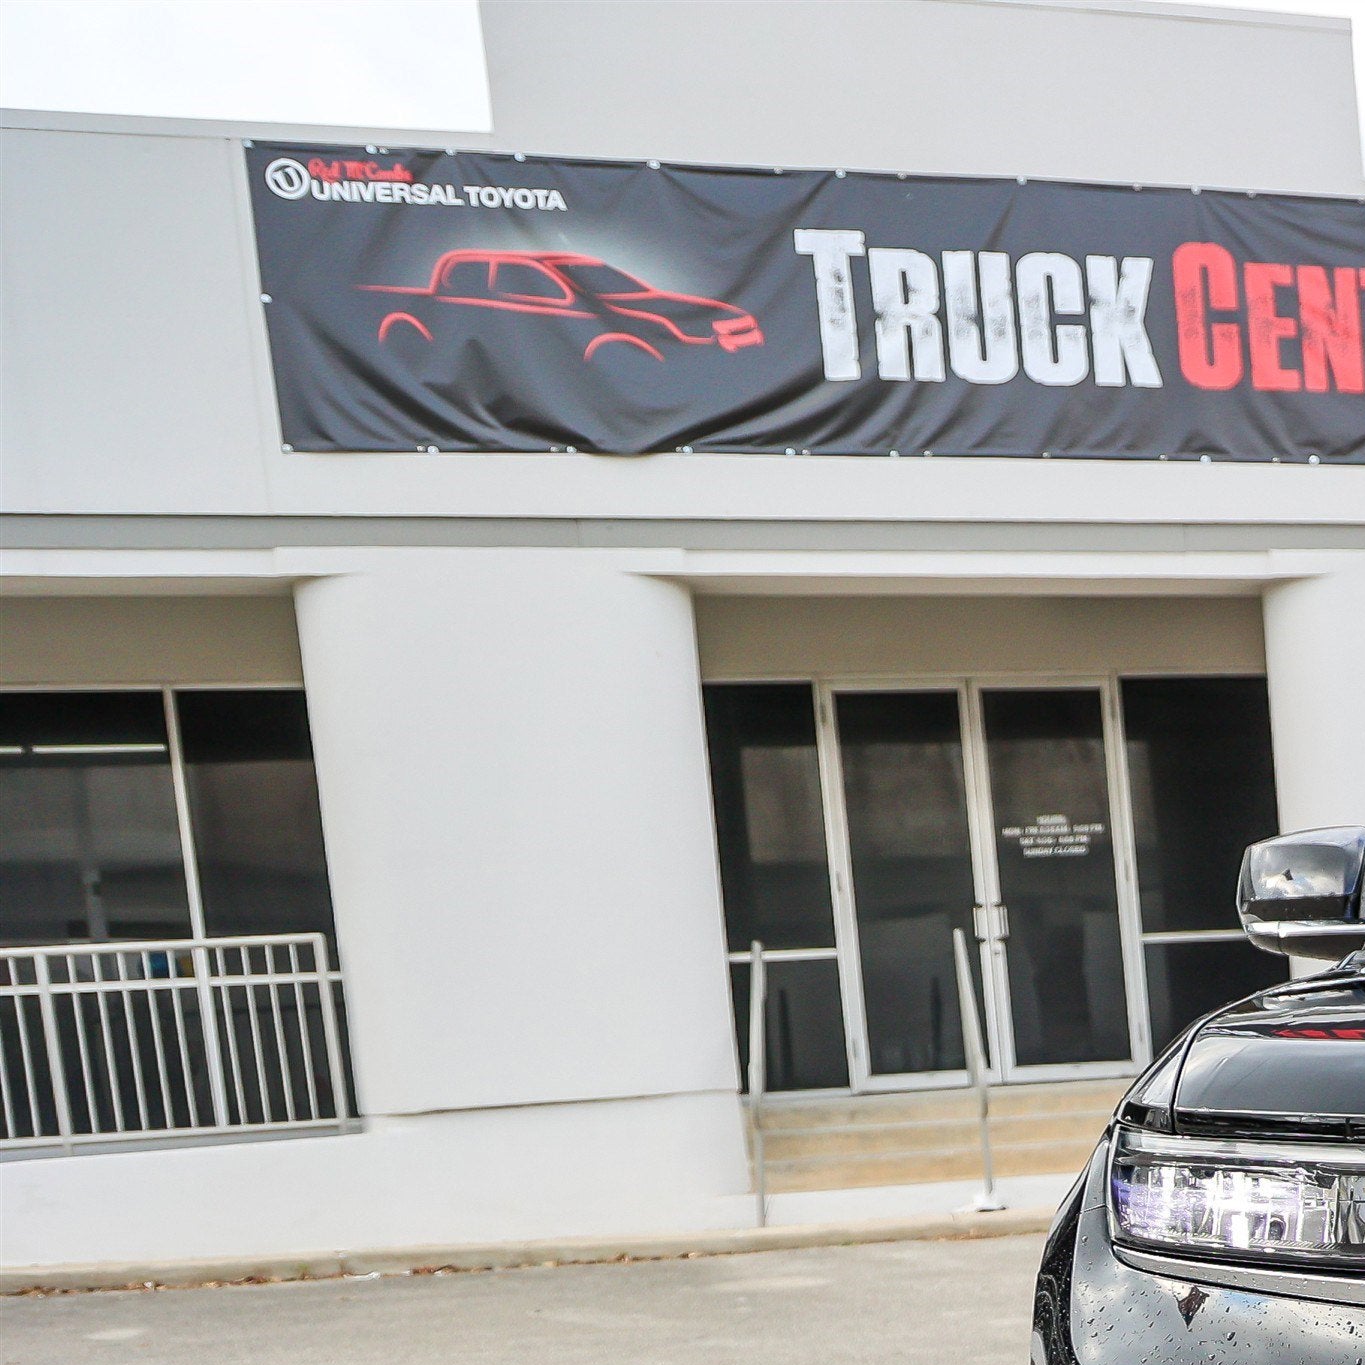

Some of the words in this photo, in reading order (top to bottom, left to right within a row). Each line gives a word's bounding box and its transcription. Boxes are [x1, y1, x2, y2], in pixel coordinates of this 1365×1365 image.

[310, 180, 465, 206] UNIVERSAL
[463, 184, 569, 212] TOYOTA
[793, 228, 1164, 389] TRUCK
